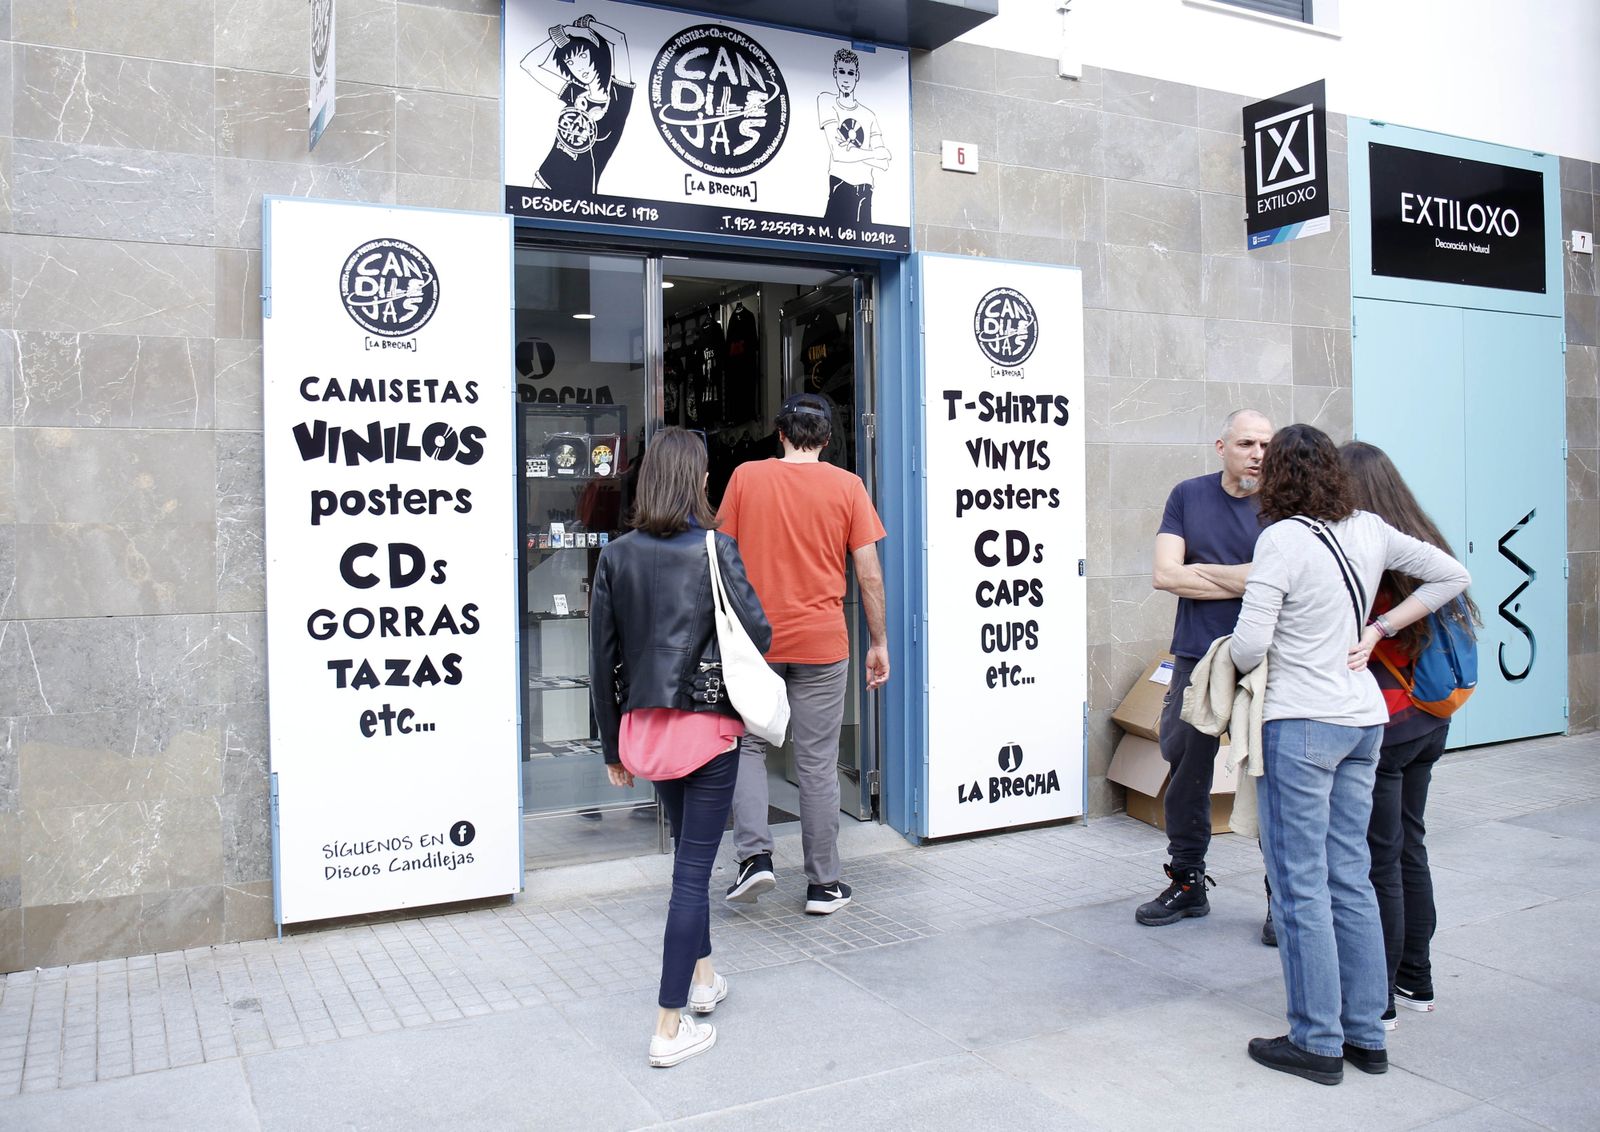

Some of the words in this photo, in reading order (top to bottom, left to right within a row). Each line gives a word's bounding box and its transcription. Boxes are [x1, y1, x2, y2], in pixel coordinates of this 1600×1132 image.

[728, 31, 747, 46] CAPS
[748, 44, 766, 62] CUPS
[958, 147, 965, 165] 6
[521, 195, 628, 219] DESDE/SINCE
[631, 206, 660, 222] 1978
[1257, 185, 1317, 214] EXTILOXO
[1401, 192, 1520, 238] EXTILOXO
[721, 215, 757, 232] T.952
[761, 219, 805, 237] 225593
[818, 226, 834, 240] M.
[838, 228, 857, 242] 681
[860, 231, 897, 246] 102912
[1580, 235, 1586, 249] 7
[1469, 242, 1490, 254] Natural
[300, 376, 479, 404] CAMISETAS
[292, 419, 488, 467] VINILOS
[965, 437, 1051, 472] VINYLS
[310, 483, 473, 526] posters
[956, 484, 1060, 518] posters
[974, 529, 1045, 567] CDs
[339, 541, 448, 590] CDs
[975, 578, 1044, 608] CAPS
[307, 603, 481, 640] GORRAS
[981, 620, 1039, 654] CUPS
[327, 653, 463, 691] TAZAS
[985, 661, 1035, 689] etc...
[359, 703, 436, 739] etc...
[958, 780, 984, 804] LA
[322, 835, 414, 860] SÍGUENOS
[420, 832, 445, 848] EN
[324, 861, 381, 881] Discos
[389, 850, 475, 874] Candilejas
